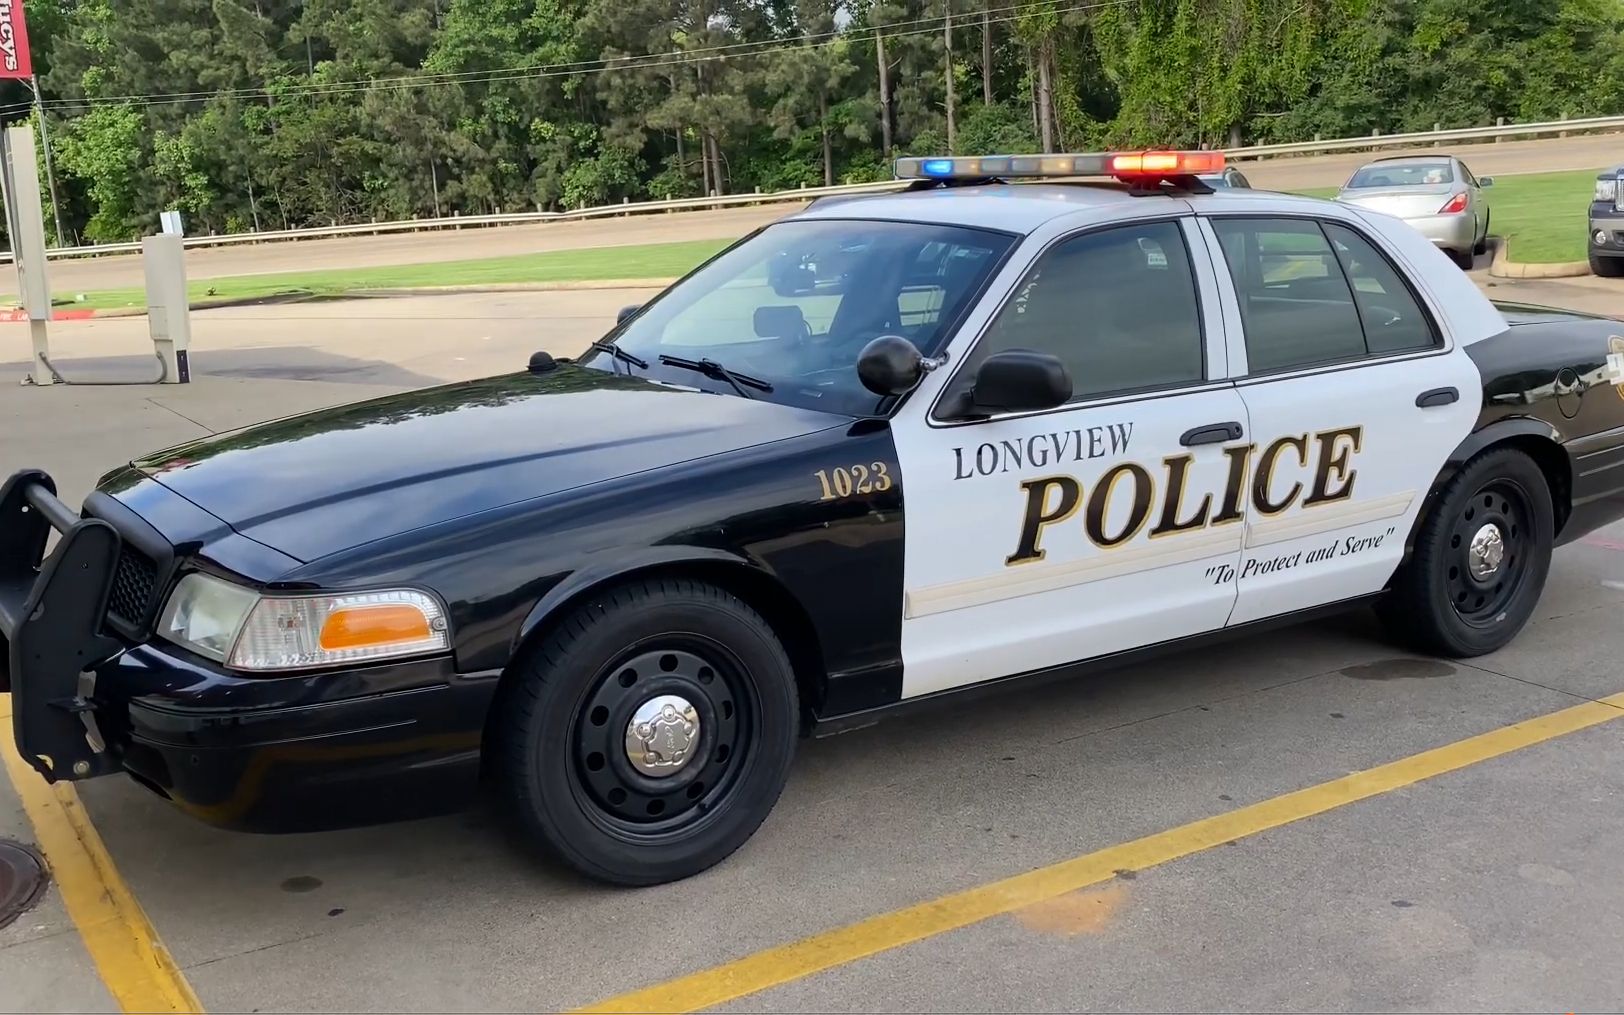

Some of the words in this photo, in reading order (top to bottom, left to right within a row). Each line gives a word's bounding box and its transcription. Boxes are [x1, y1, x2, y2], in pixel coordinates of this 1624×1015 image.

[814, 461, 892, 500] 1023
[952, 422, 1134, 481] LONGVIEW
[1005, 424, 1364, 567] POLICE
[1205, 564, 1235, 585] "To
[1240, 551, 1302, 579] Protect
[1305, 540, 1339, 564] and
[1340, 527, 1396, 556] Serve"
